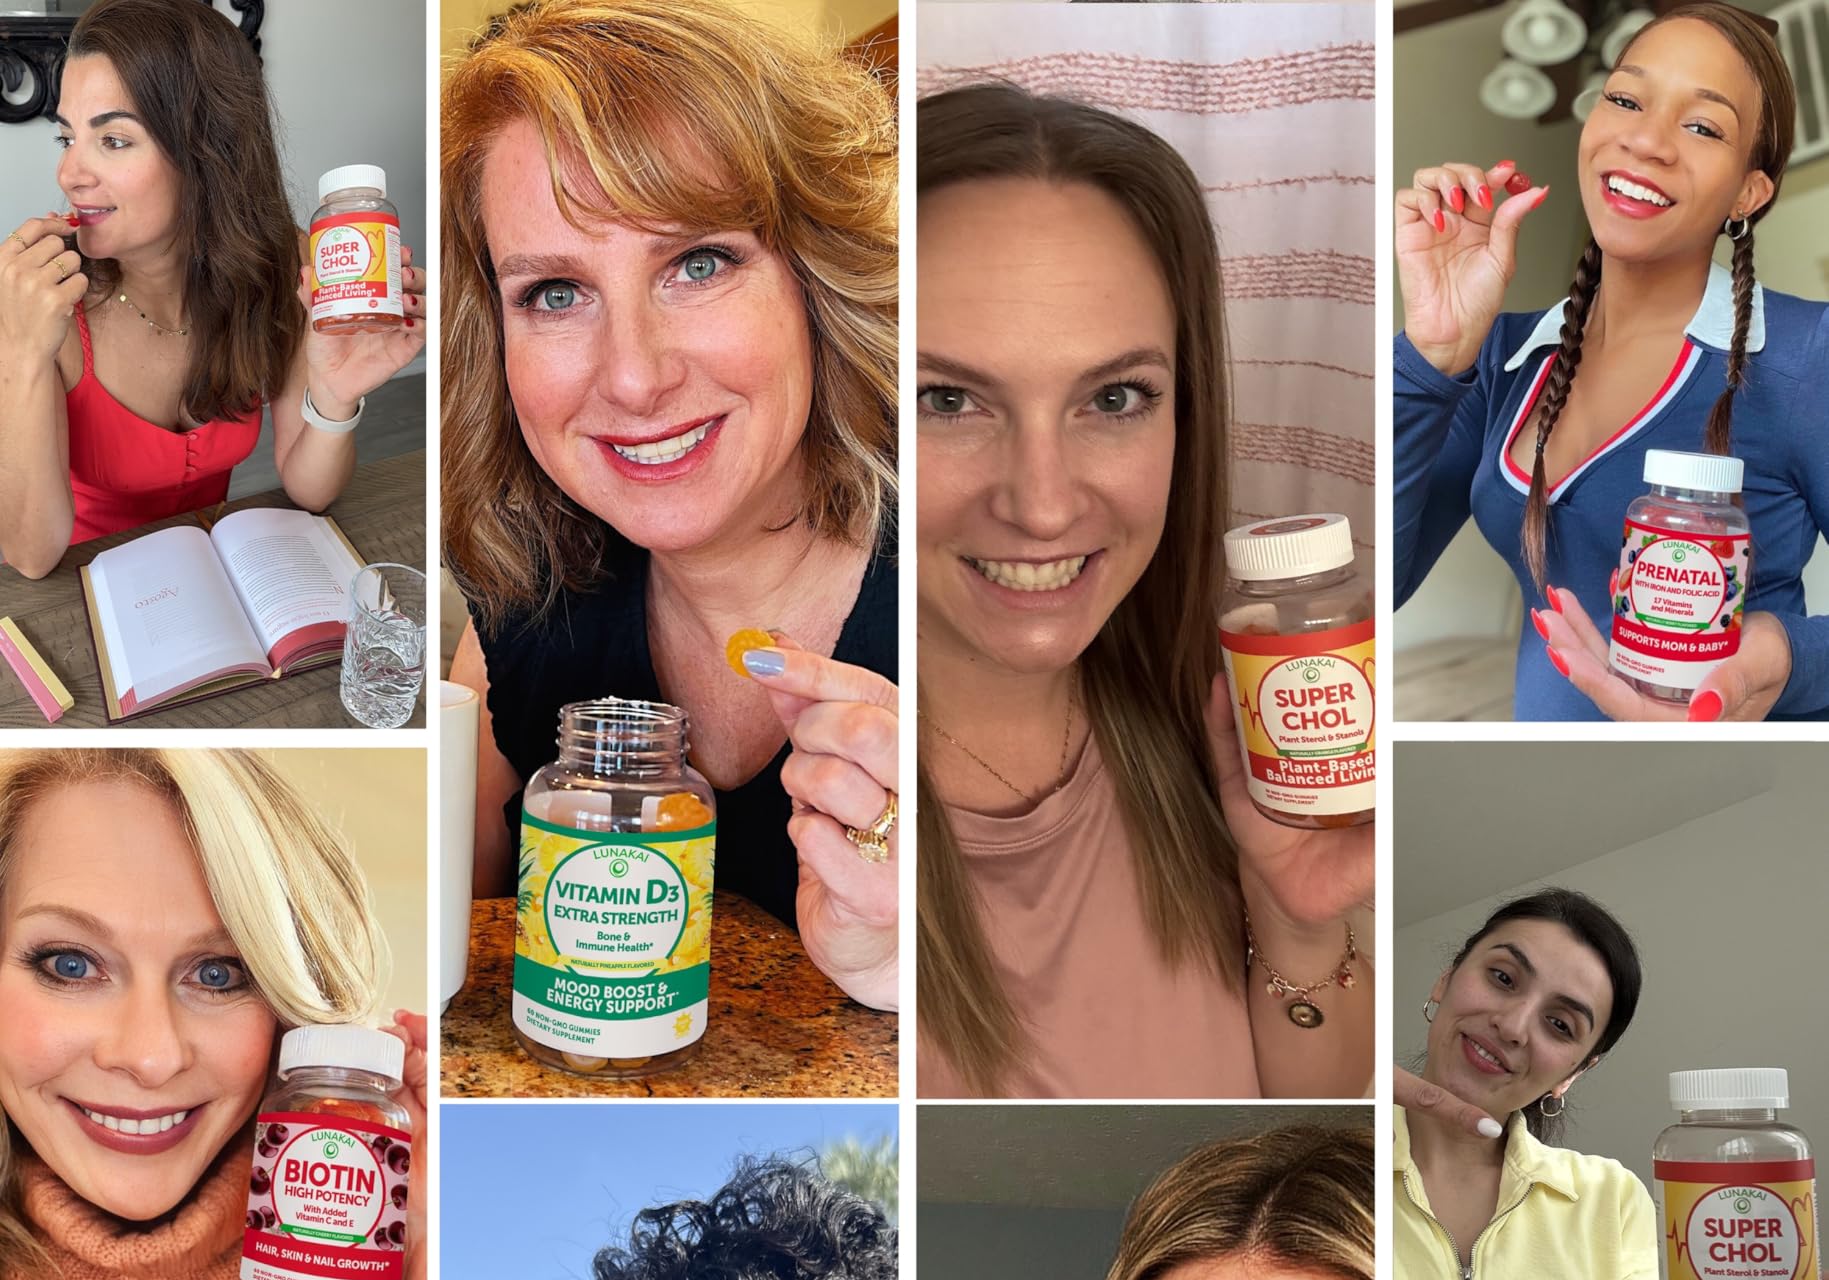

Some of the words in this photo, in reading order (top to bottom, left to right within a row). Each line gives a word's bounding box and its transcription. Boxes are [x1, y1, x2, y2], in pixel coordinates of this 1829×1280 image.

[320, 242, 359, 257] SUPER
[322, 255, 358, 269] CHOL
[319, 282, 366, 295] Plant-Based
[1663, 542, 1701, 554] LUNAKAI
[1637, 561, 1720, 585] PRENATAL
[1635, 580, 1649, 588] WITH
[1650, 583, 1666, 592] IRON
[134, 586, 179, 609] Agosto
[1663, 599, 1692, 608] Vitamins
[1665, 607, 1694, 616] Minerals
[1619, 627, 1660, 648] SUPPORTS
[1661, 641, 1687, 652] MOM
[1689, 644, 1696, 652] &
[1286, 658, 1336, 672] LUNAKAI
[1274, 683, 1356, 707] SUPER
[1282, 707, 1356, 730] CHOL
[1279, 735, 1300, 743] Plant
[1301, 735, 1326, 743] Sterol
[1335, 729, 1364, 740] Stanols
[1279, 753, 1374, 773] Plant-Based
[1266, 768, 1335, 784] Balanced
[593, 848, 650, 862] LUNAKAI
[556, 880, 640, 904] VITAMIN
[646, 879, 679, 904] D3
[554, 904, 598, 923] EXTRA
[601, 909, 678, 924] STRENGTH
[597, 932, 621, 940] Bone
[624, 932, 630, 940] &
[576, 939, 615, 951] Immune
[570, 960, 598, 968] NATURALLY
[554, 978, 600, 996] MOOD
[604, 984, 655, 998] BOOST
[658, 982, 668, 994] &
[546, 988, 603, 1012] ENERGY
[527, 1007, 535, 1016] 60
[535, 1010, 567, 1029] NON-GMO
[568, 1024, 600, 1035] GUMMIES
[526, 1016, 550, 1032] DIETARY
[552, 1028, 595, 1044] SUPPLEMENT
[311, 1132, 356, 1148] LUNAKAI
[285, 1159, 376, 1194] BIOTIN
[285, 1185, 314, 1199] HIGH
[316, 1190, 370, 1207] POTENCY
[1718, 1189, 1767, 1200] LUNAKAI
[304, 1204, 320, 1213] With
[322, 1208, 347, 1217] Added
[296, 1212, 324, 1223] Vitamin
[333, 1218, 347, 1226] and
[1704, 1218, 1783, 1238] SUPER
[256, 1242, 280, 1257] HAIR,
[281, 1249, 303, 1262] SKIN
[304, 1253, 312, 1263] &
[313, 1256, 335, 1267] NAIL
[1709, 1242, 1782, 1263] CHOL
[260, 1270, 286, 1280] NON-GMO
[1704, 1267, 1725, 1276] Plant
[1727, 1268, 1752, 1276] Sterol
[1761, 1268, 1789, 1276] Stanols
